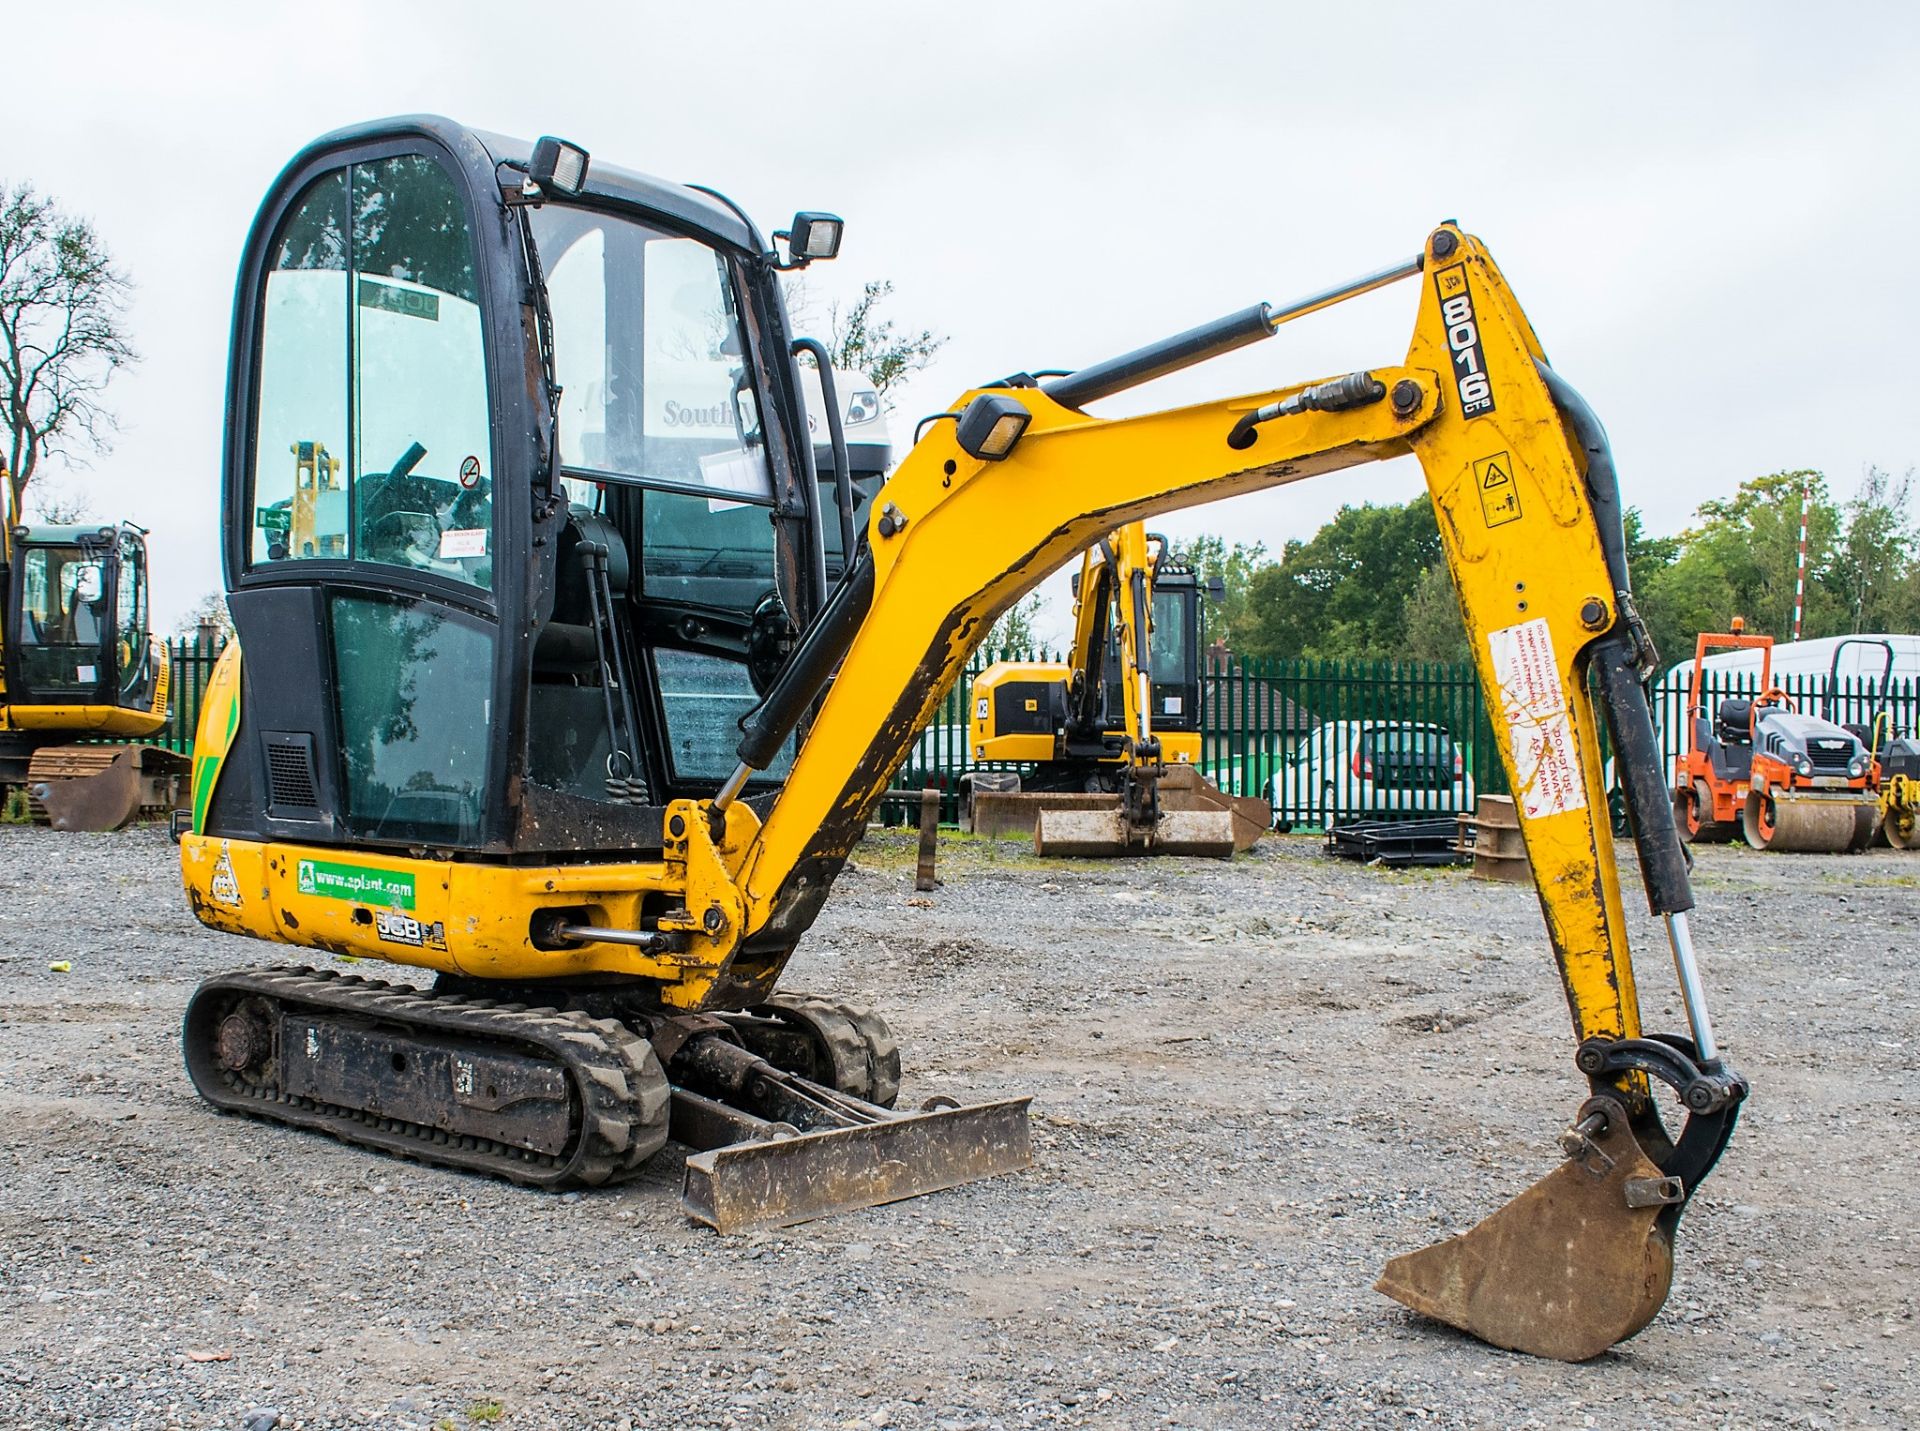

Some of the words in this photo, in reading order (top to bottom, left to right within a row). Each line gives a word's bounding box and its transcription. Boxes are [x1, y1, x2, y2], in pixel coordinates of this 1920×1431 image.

[1443, 296, 1490, 403] 8016
[663, 400, 734, 427] South
[1464, 398, 1490, 413] CTS
[1535, 624, 1543, 636] DO
[1539, 637, 1547, 653] NOT
[1534, 663, 1542, 680] RAM
[1542, 654, 1553, 677] FULLY
[1512, 665, 1523, 691] FITTED
[1537, 681, 1549, 710] WHST
[1531, 736, 1540, 750] AS
[1553, 730, 1562, 746] DO
[1562, 774, 1573, 794] USE
[377, 914, 422, 940] JCB
